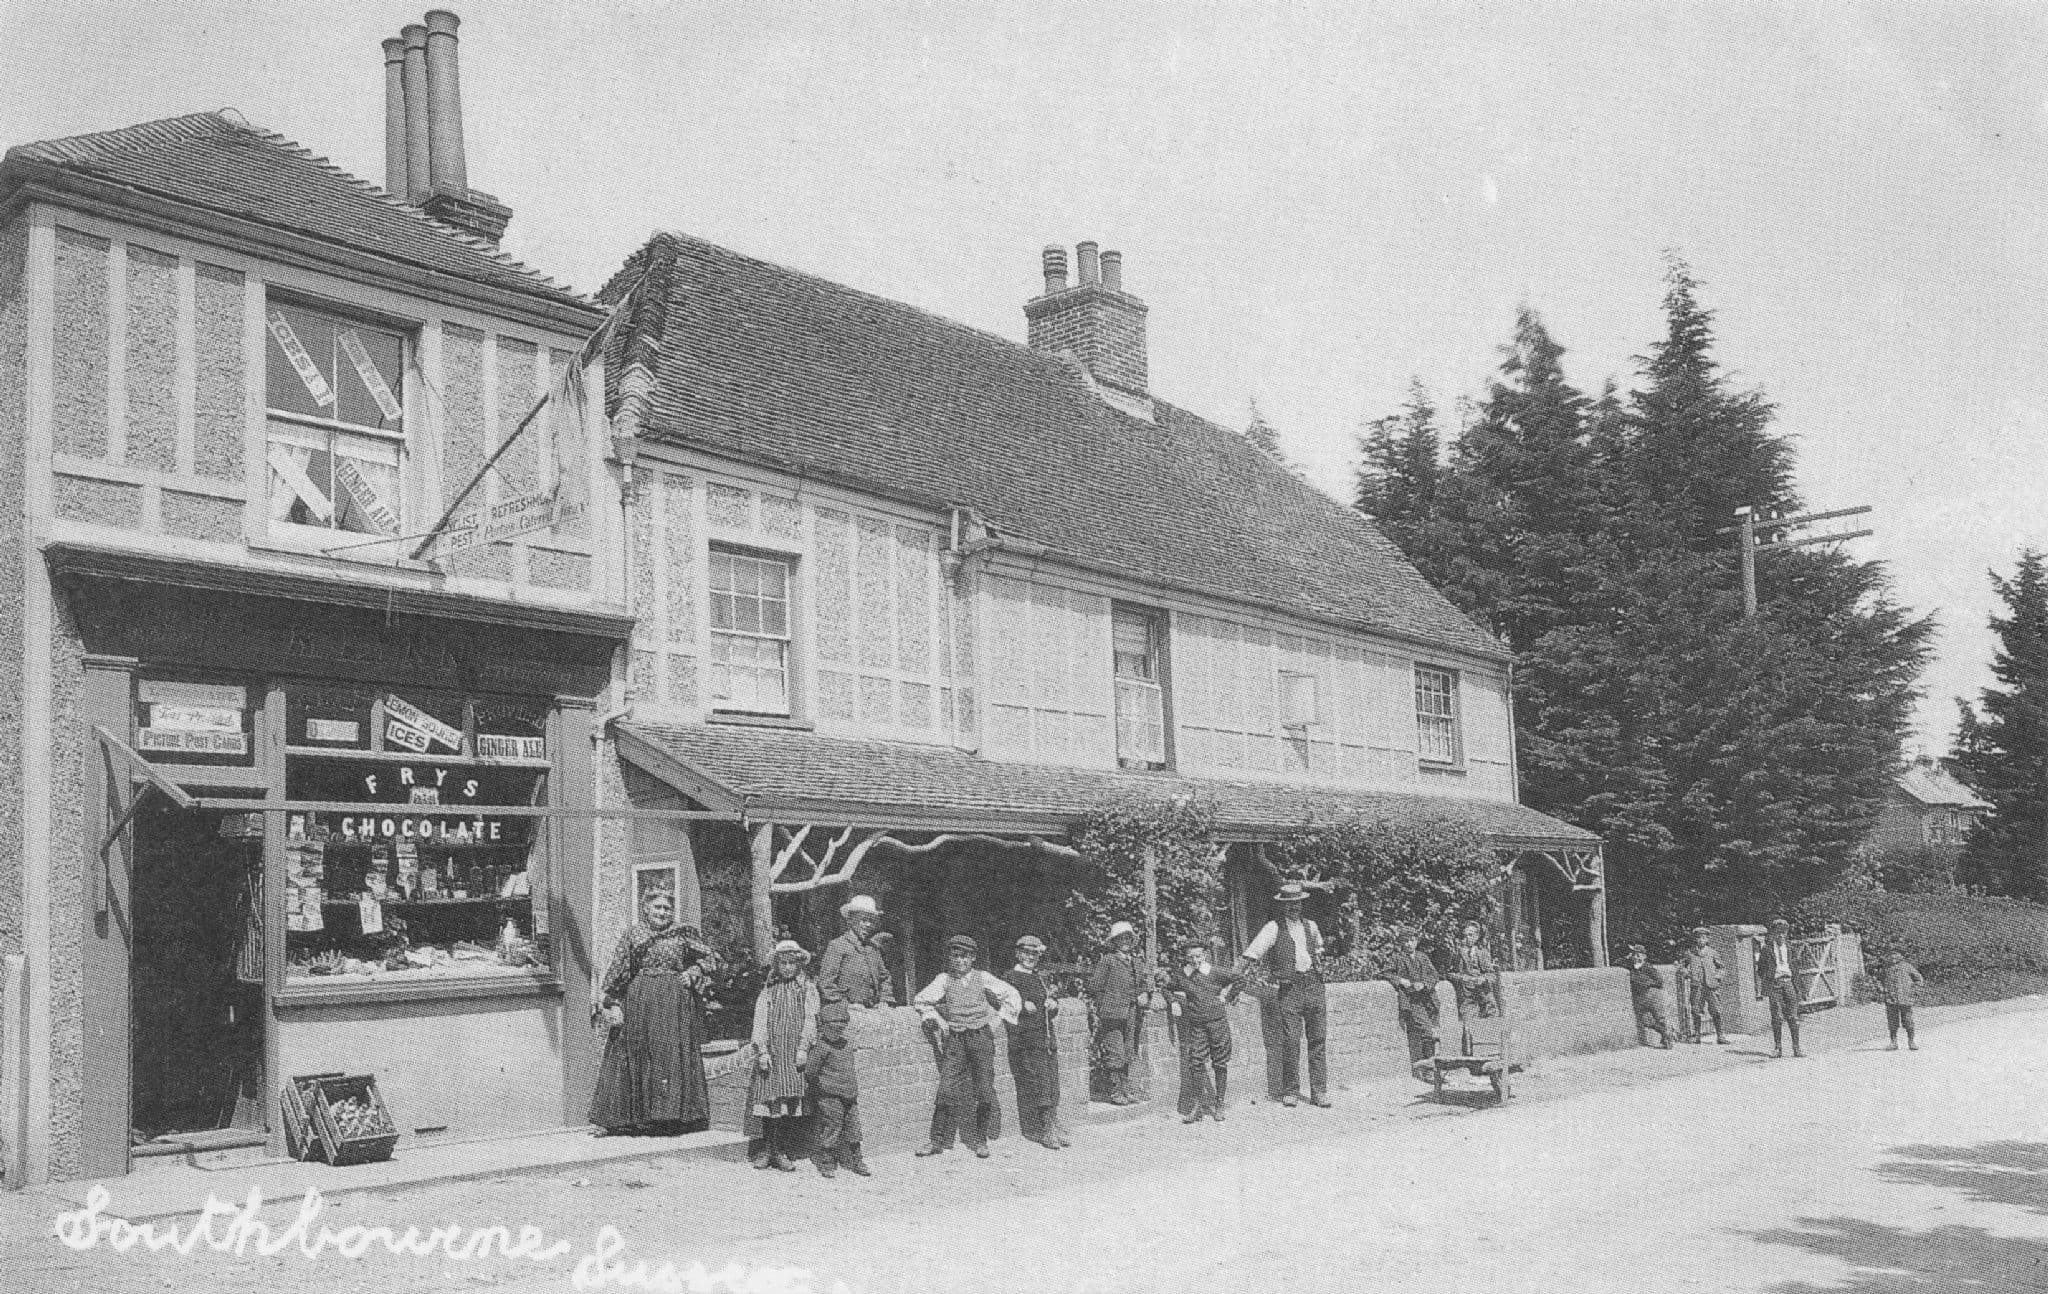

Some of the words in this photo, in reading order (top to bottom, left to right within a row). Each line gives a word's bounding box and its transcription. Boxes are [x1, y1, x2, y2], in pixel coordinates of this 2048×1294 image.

[339, 462, 377, 508] GINGER
[388, 723, 426, 749] ICES
[479, 737, 518, 757] GINGER
[523, 739, 542, 758] ALE
[341, 817, 501, 840] CHOCOLATE
